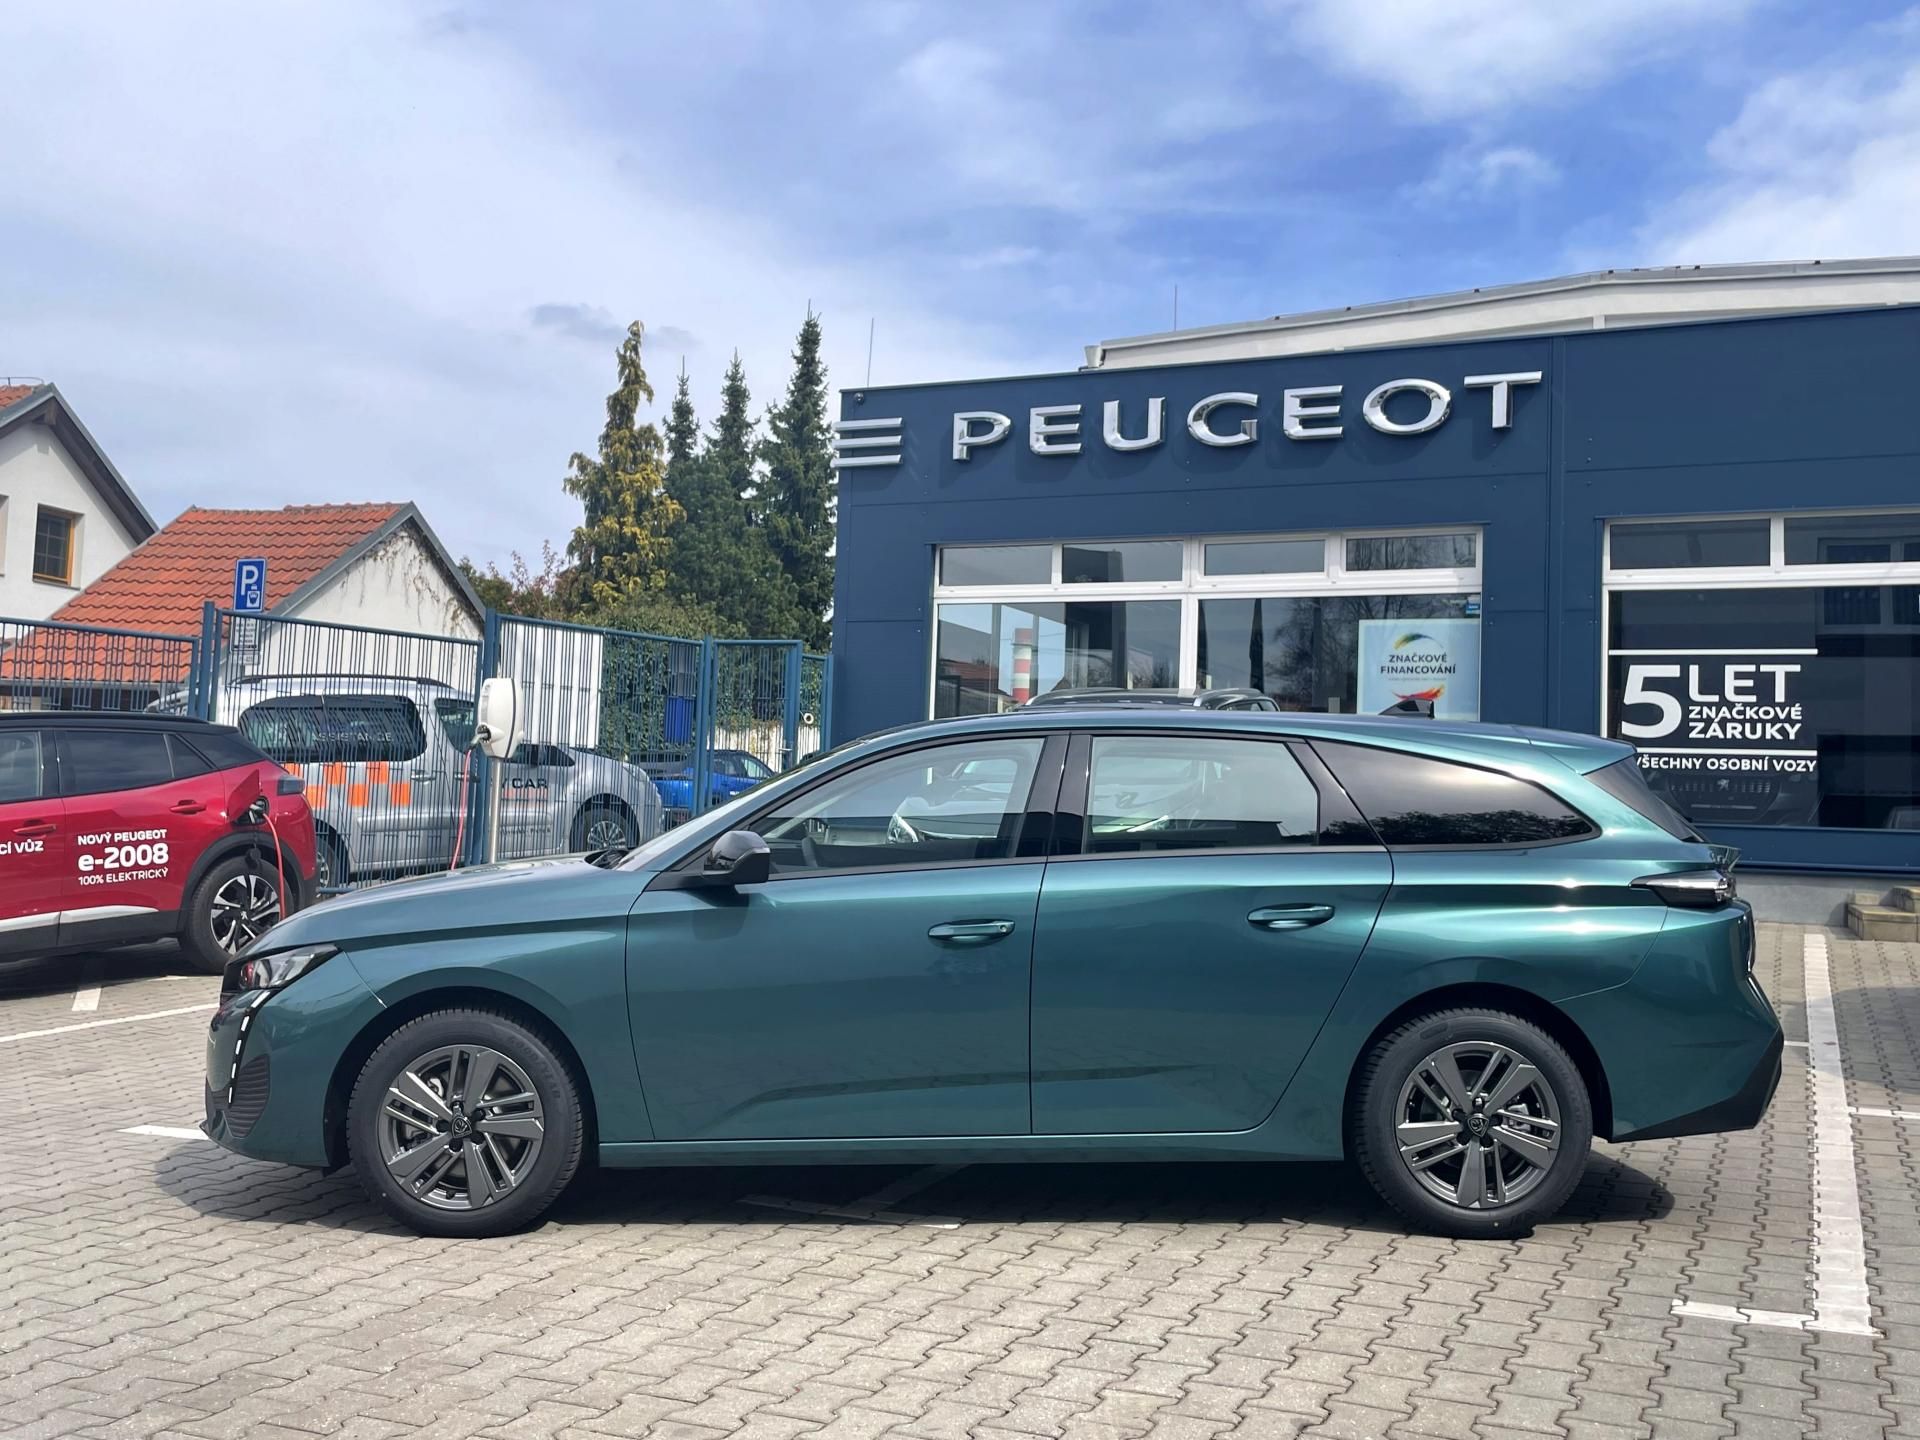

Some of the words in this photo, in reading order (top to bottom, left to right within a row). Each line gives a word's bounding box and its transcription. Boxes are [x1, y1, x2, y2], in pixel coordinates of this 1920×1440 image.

[952, 371, 1544, 462] PEUGEOT
[241, 565, 259, 596] P
[1389, 652, 1447, 663] ZNAČKOVÉ
[1380, 664, 1456, 674] FINANCOVÁNÍ
[1621, 664, 1682, 738] 5
[1688, 664, 1801, 703] LET
[1688, 703, 1803, 720] ZNAČKOVÉ
[1688, 717, 1802, 740] ZÁRUKY
[1706, 756, 1769, 771] OSOBNÍ
[1773, 759, 1817, 772] VOZY
[511, 778, 548, 789] CAR
[14, 838, 44, 854] VŮZ
[77, 833, 110, 846] NOVÝ
[114, 829, 168, 843] PEUGEOT
[77, 842, 169, 872] e-2008
[78, 875, 104, 886] 100%
[105, 867, 169, 884] ELEKTRICKÝ
